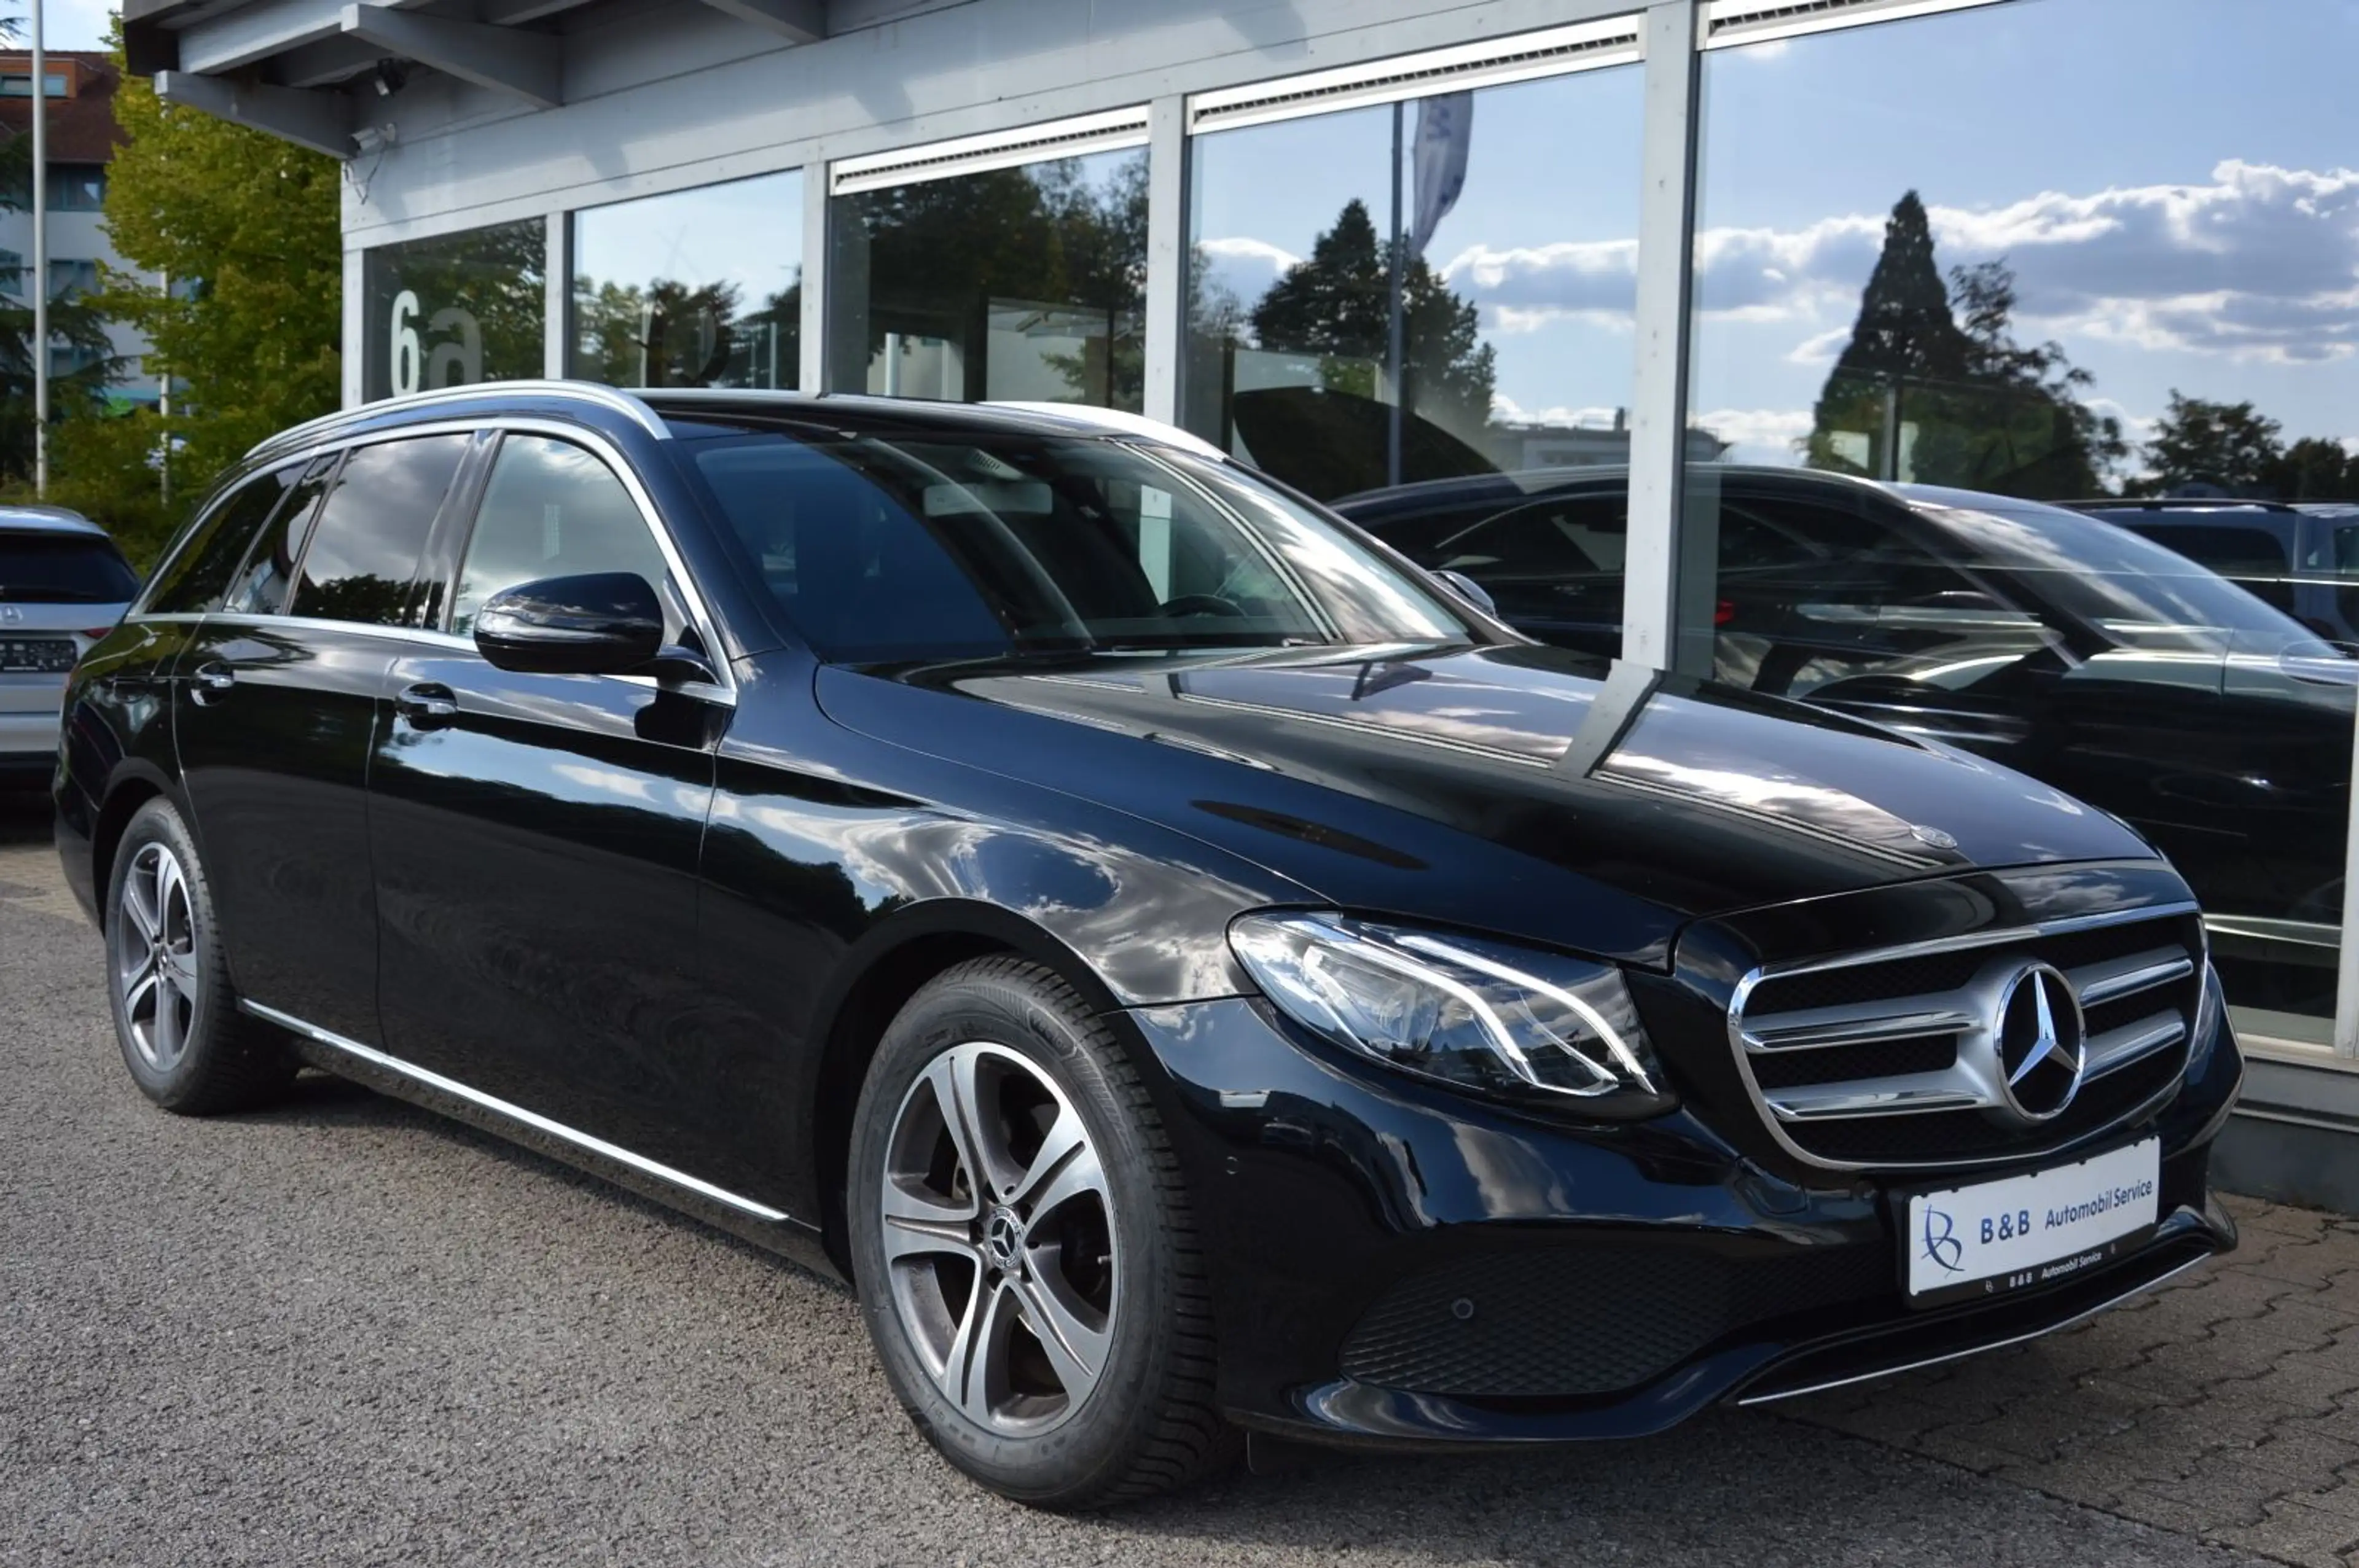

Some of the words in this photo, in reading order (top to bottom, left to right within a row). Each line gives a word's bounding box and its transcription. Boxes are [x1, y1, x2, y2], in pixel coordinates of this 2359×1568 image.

[391, 290, 420, 398] 6
[2044, 1193, 2112, 1230] Automobil
[2113, 1179, 2153, 1208] Service
[2041, 1258, 2079, 1279] Automobil
[2079, 1251, 2102, 1268] Service
